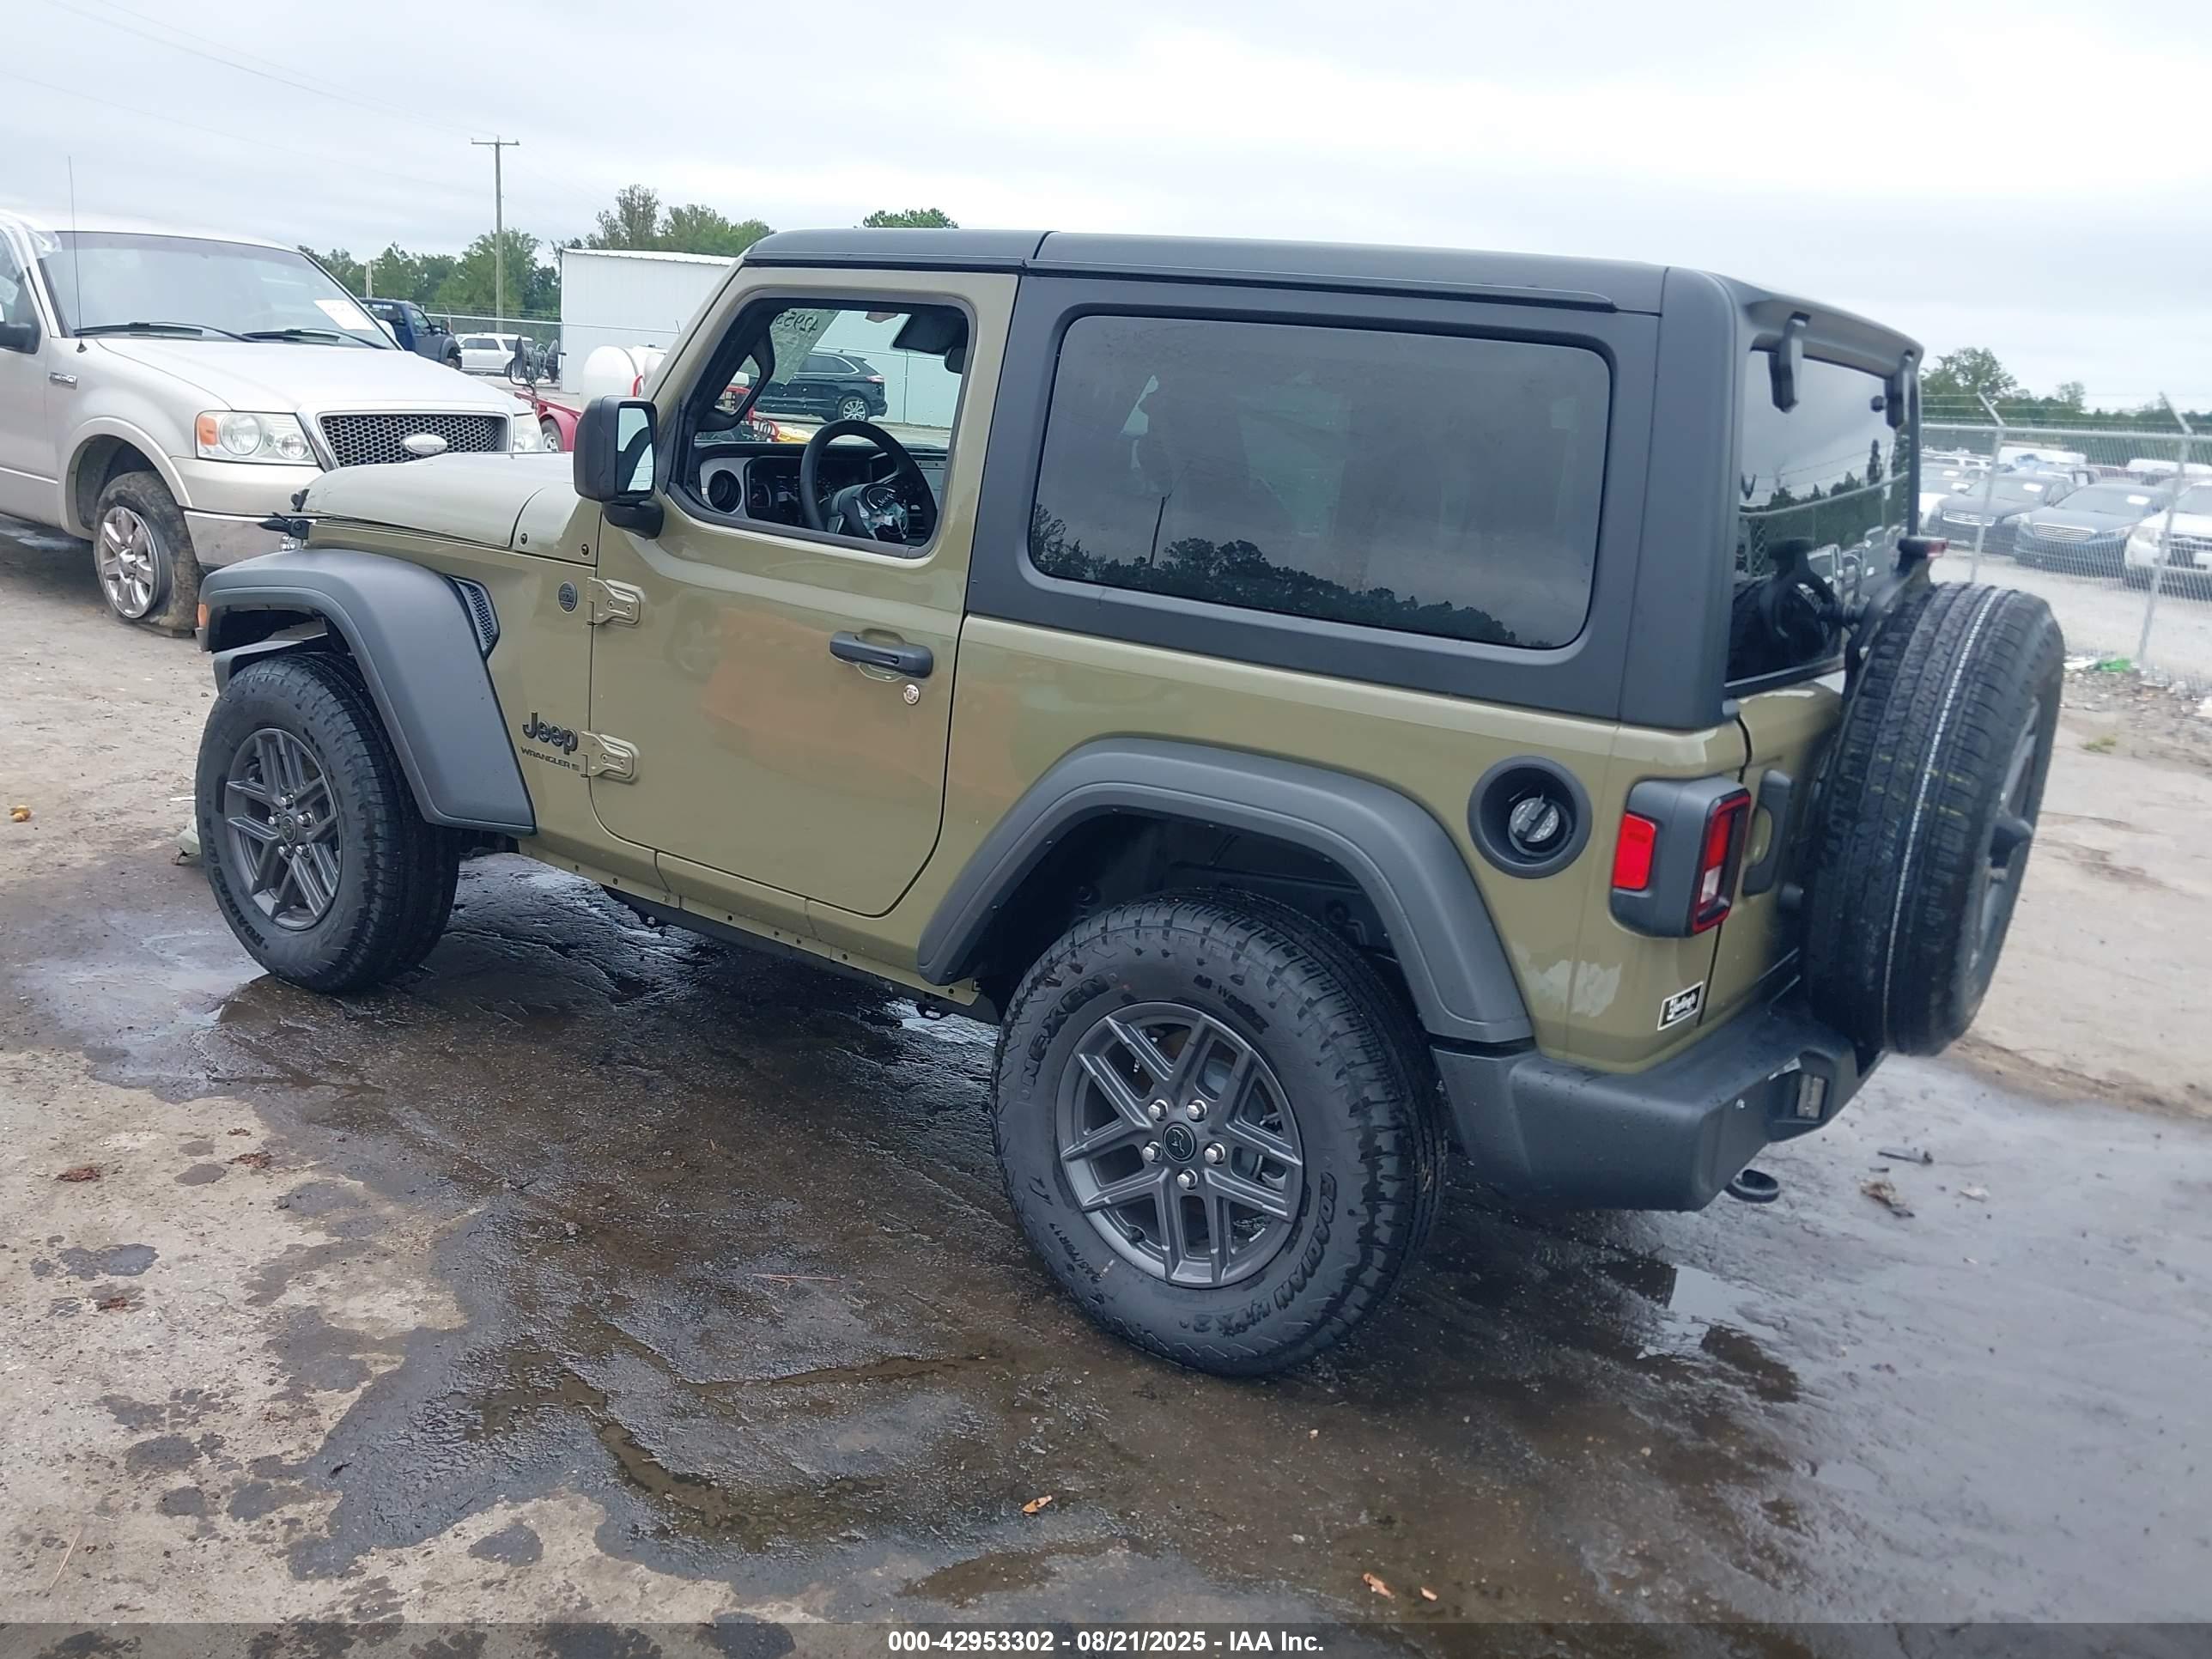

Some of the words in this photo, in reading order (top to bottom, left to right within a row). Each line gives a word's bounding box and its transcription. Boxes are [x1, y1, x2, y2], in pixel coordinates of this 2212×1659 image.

[520, 746, 570, 769] WRANGLER
[522, 711, 579, 756] Jeep
[1021, 974, 1111, 1087] NEXEN
[1273, 1171, 1338, 1311] ROADIAN
